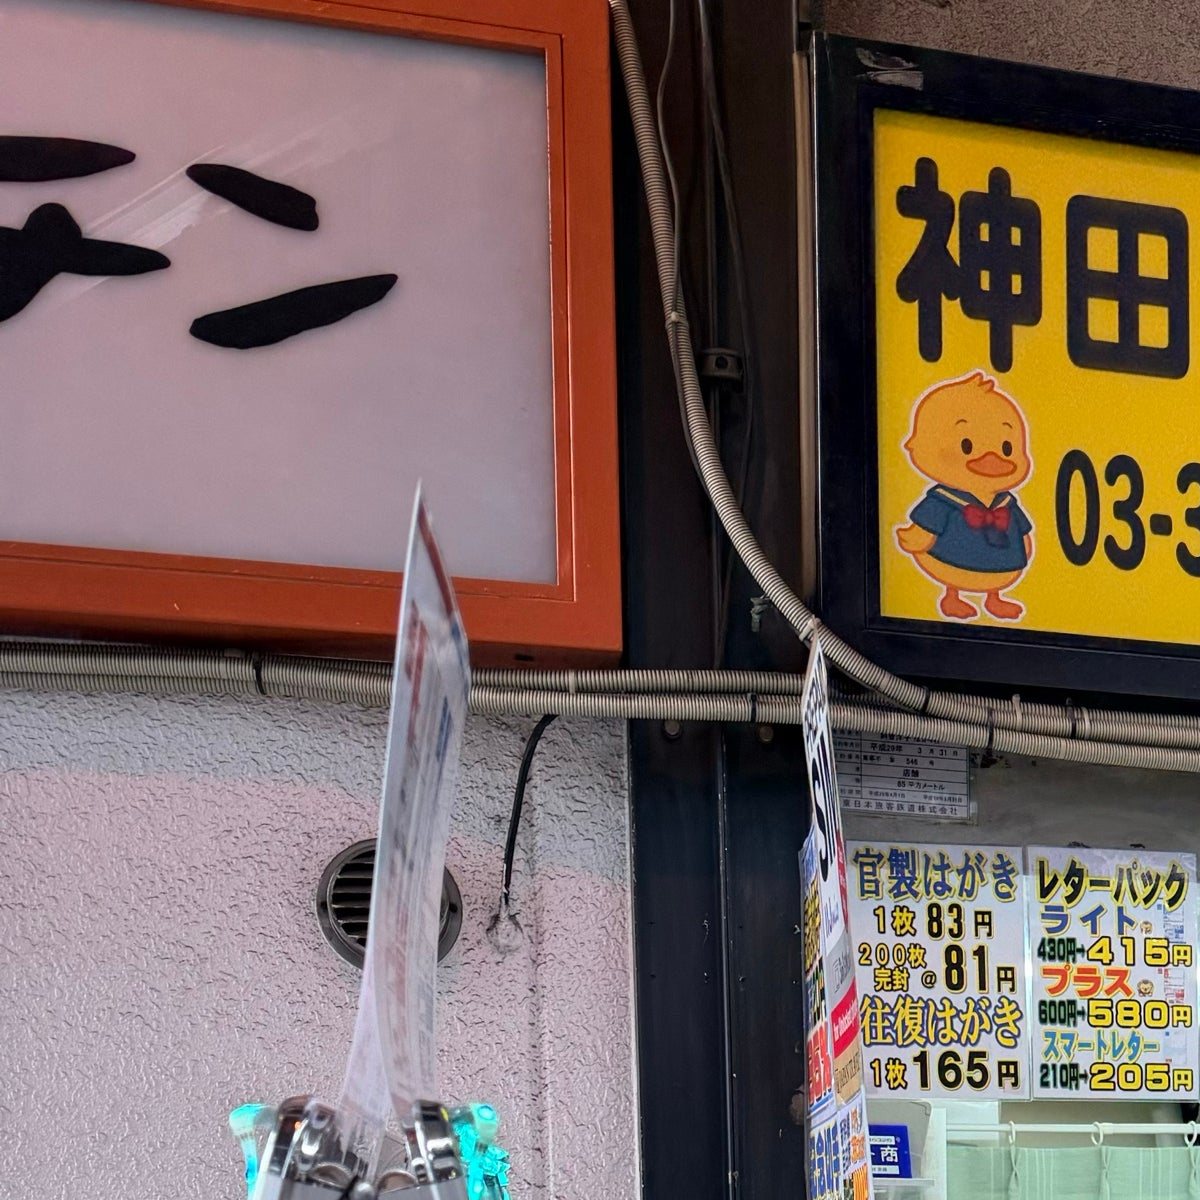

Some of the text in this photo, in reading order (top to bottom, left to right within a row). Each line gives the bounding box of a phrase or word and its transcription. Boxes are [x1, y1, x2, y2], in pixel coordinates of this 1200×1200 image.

[853, 847, 1018, 902] 官製はがき
[1036, 857, 1189, 913] レターパック
[1040, 903, 1137, 937] ライト
[858, 943, 927, 968] 200枚
[874, 968, 910, 992] 完封
[1041, 964, 1135, 999] プラス
[859, 995, 1023, 1048] 往復はがき
[1042, 1029, 1160, 1062] スマートレター
